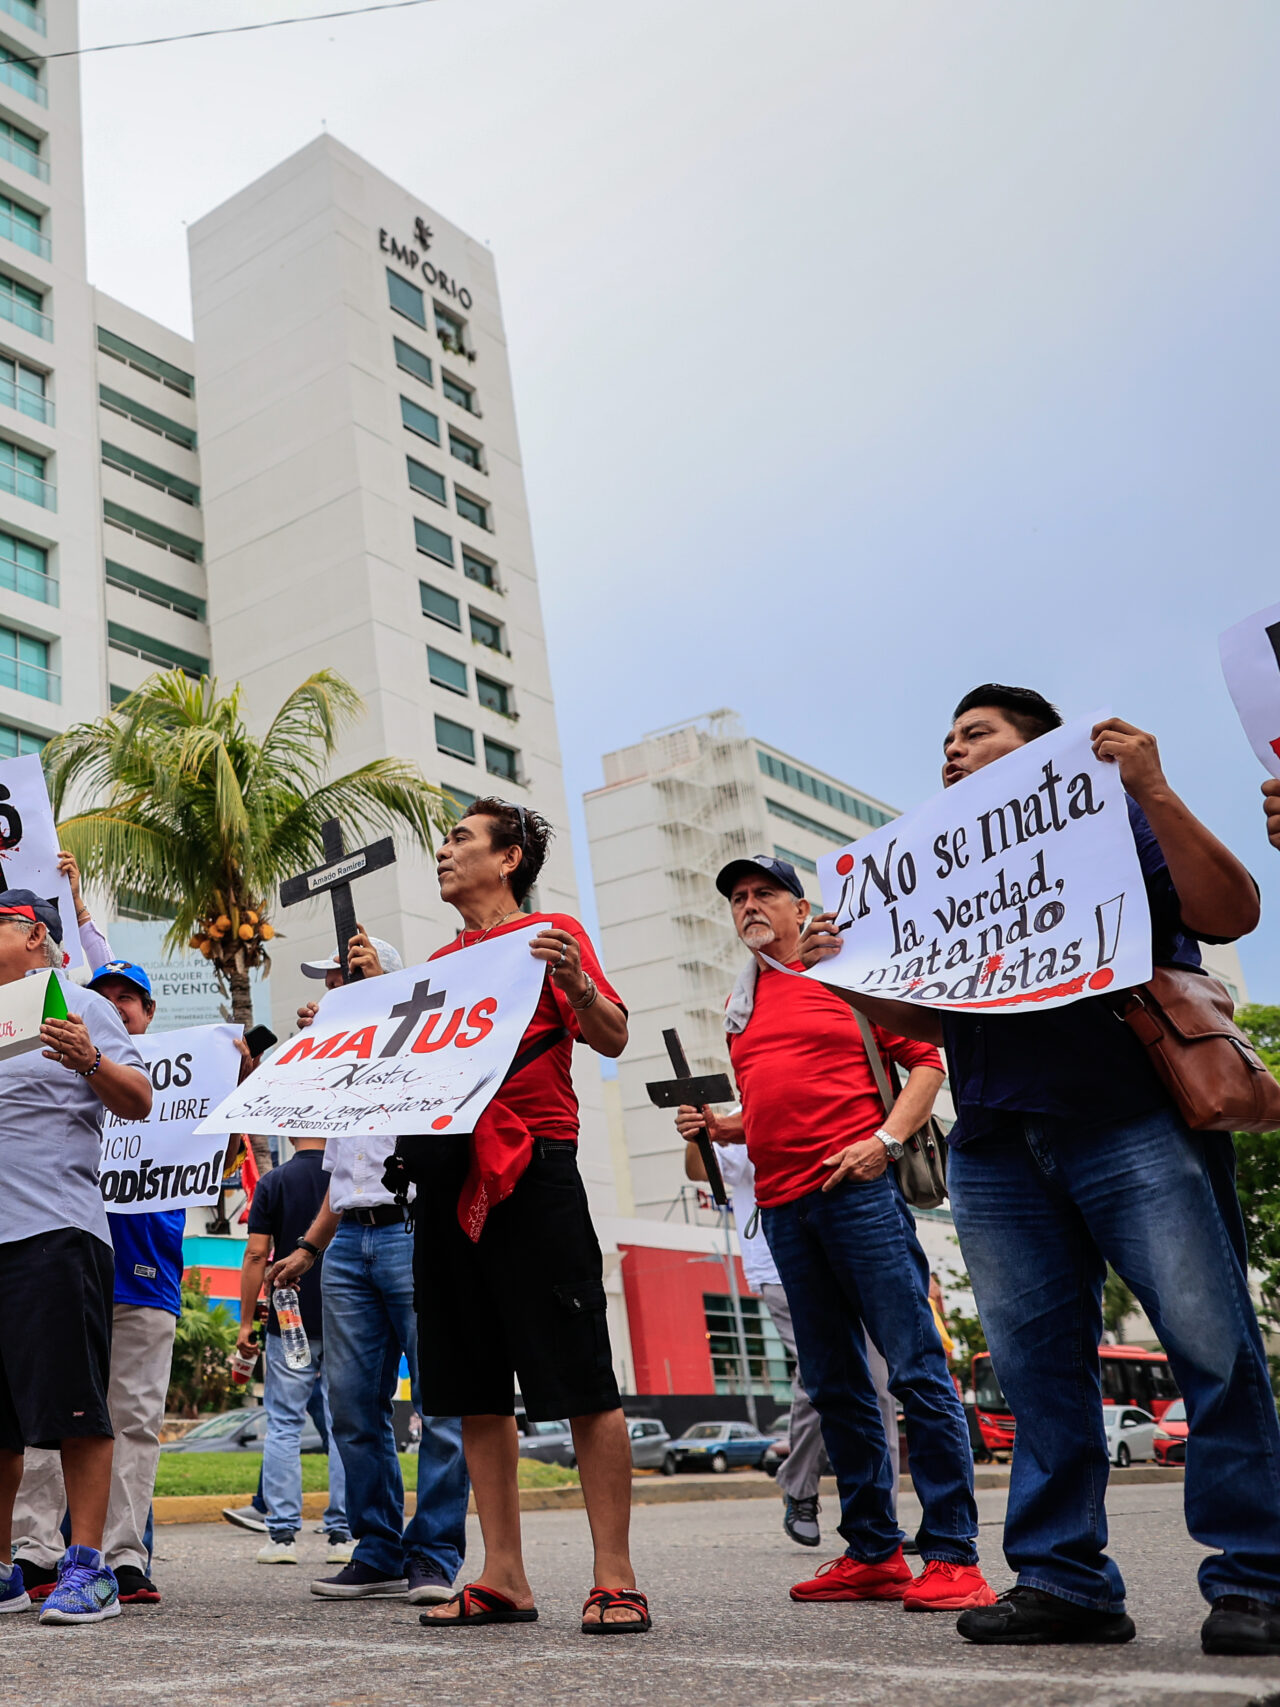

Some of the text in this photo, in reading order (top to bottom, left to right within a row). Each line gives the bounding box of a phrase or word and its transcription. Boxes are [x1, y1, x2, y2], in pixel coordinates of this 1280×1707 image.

[378, 227, 473, 311] EMPORIO
[933, 827, 970, 879] se
[977, 759, 1105, 864] mata
[312, 859, 366, 887] Amado Ramírez
[889, 849, 1065, 959] la verdad,
[860, 901, 1066, 985] matando
[163, 983, 221, 996] EVENTO
[275, 978, 498, 1066] MATUS
[316, 1061, 424, 1089] Hasta
[159, 1098, 210, 1122] LIBRE
[226, 1096, 322, 1123] Siempre
[283, 1118, 350, 1132] PERIODISTA
[96, 1150, 225, 1204] ODÍSTICO!
